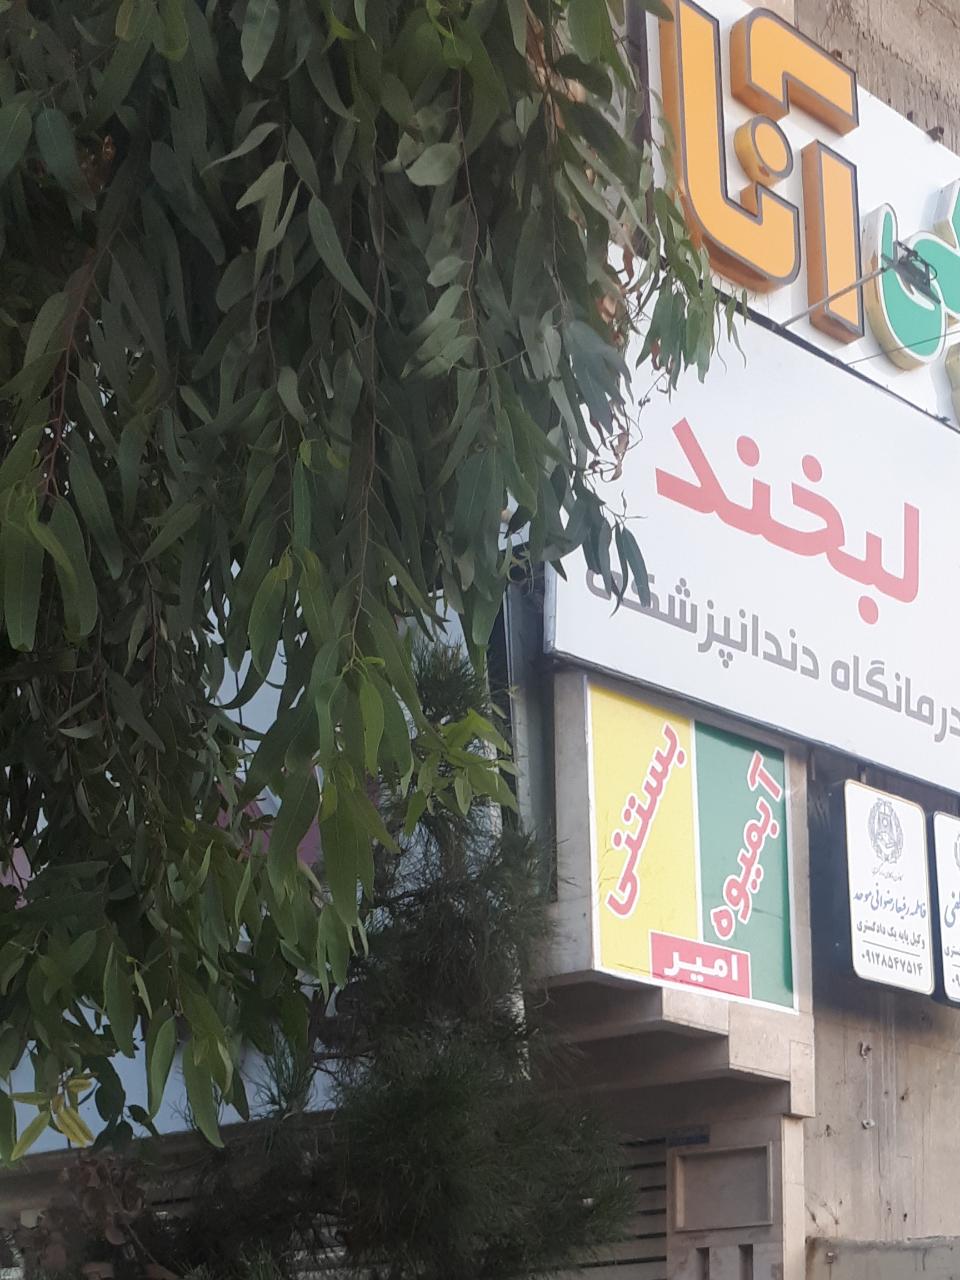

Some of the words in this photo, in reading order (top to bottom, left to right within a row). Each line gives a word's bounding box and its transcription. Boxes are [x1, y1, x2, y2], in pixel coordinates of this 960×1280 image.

[655, 416, 919, 625] لبخند
[606, 722, 687, 918] بستنی
[711, 750, 783, 940] آبمیوه
[856, 919, 886, 934] دادگستری
[887, 926, 897, 942] یک
[898, 929, 909, 945] پایه
[910, 932, 926, 949] وکیل
[663, 950, 739, 983] امیر
[861, 949, 923, 977] ۰۹۱۲۸۵۴۷۵۱۴
